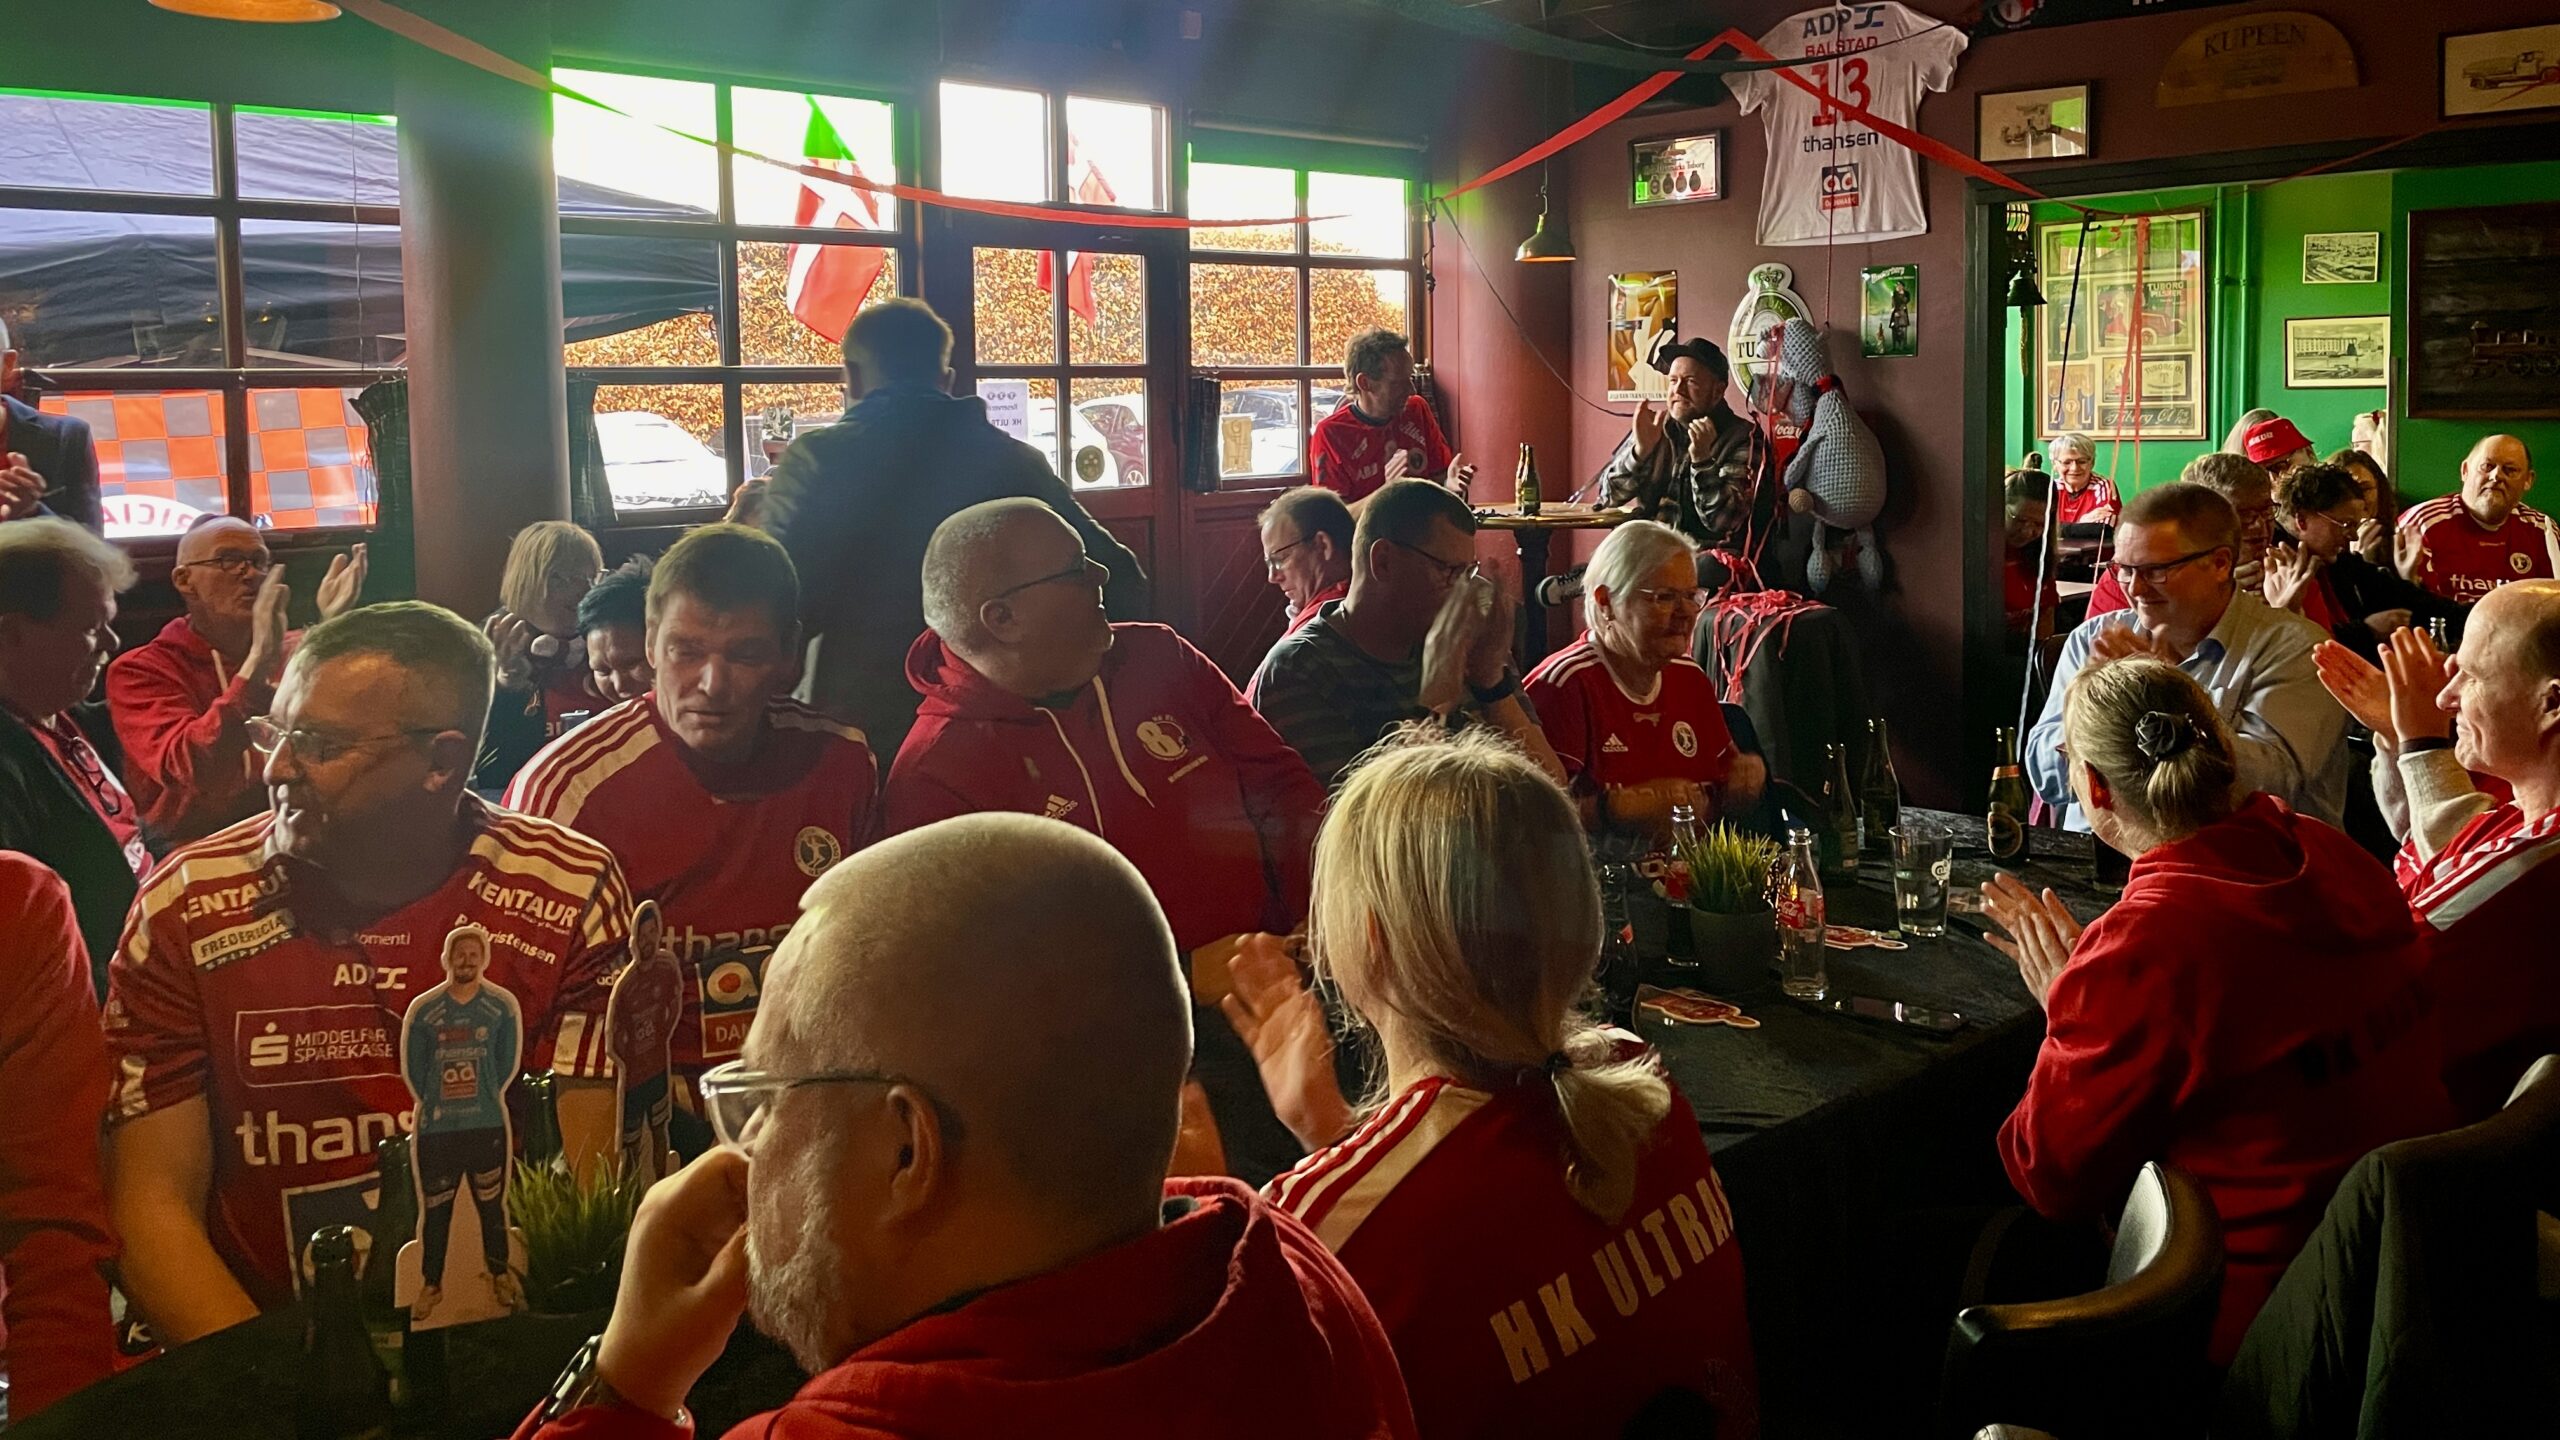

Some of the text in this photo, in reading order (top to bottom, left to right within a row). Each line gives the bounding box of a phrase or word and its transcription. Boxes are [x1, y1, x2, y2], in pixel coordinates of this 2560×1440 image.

[1803, 9, 1852, 39] ADP
[1811, 57, 1871, 127] 13
[1803, 131, 1879, 153] thansen
[2147, 281, 2184, 292] TUBORG
[1735, 341, 1761, 359] TU
[180, 865, 289, 923] ENTAU
[468, 871, 578, 928] KENTAUR
[354, 932, 411, 945] omenti
[333, 962, 375, 987] AD
[295, 1028, 389, 1047] MIDDELFAR
[1489, 1271, 1598, 1384] HK
